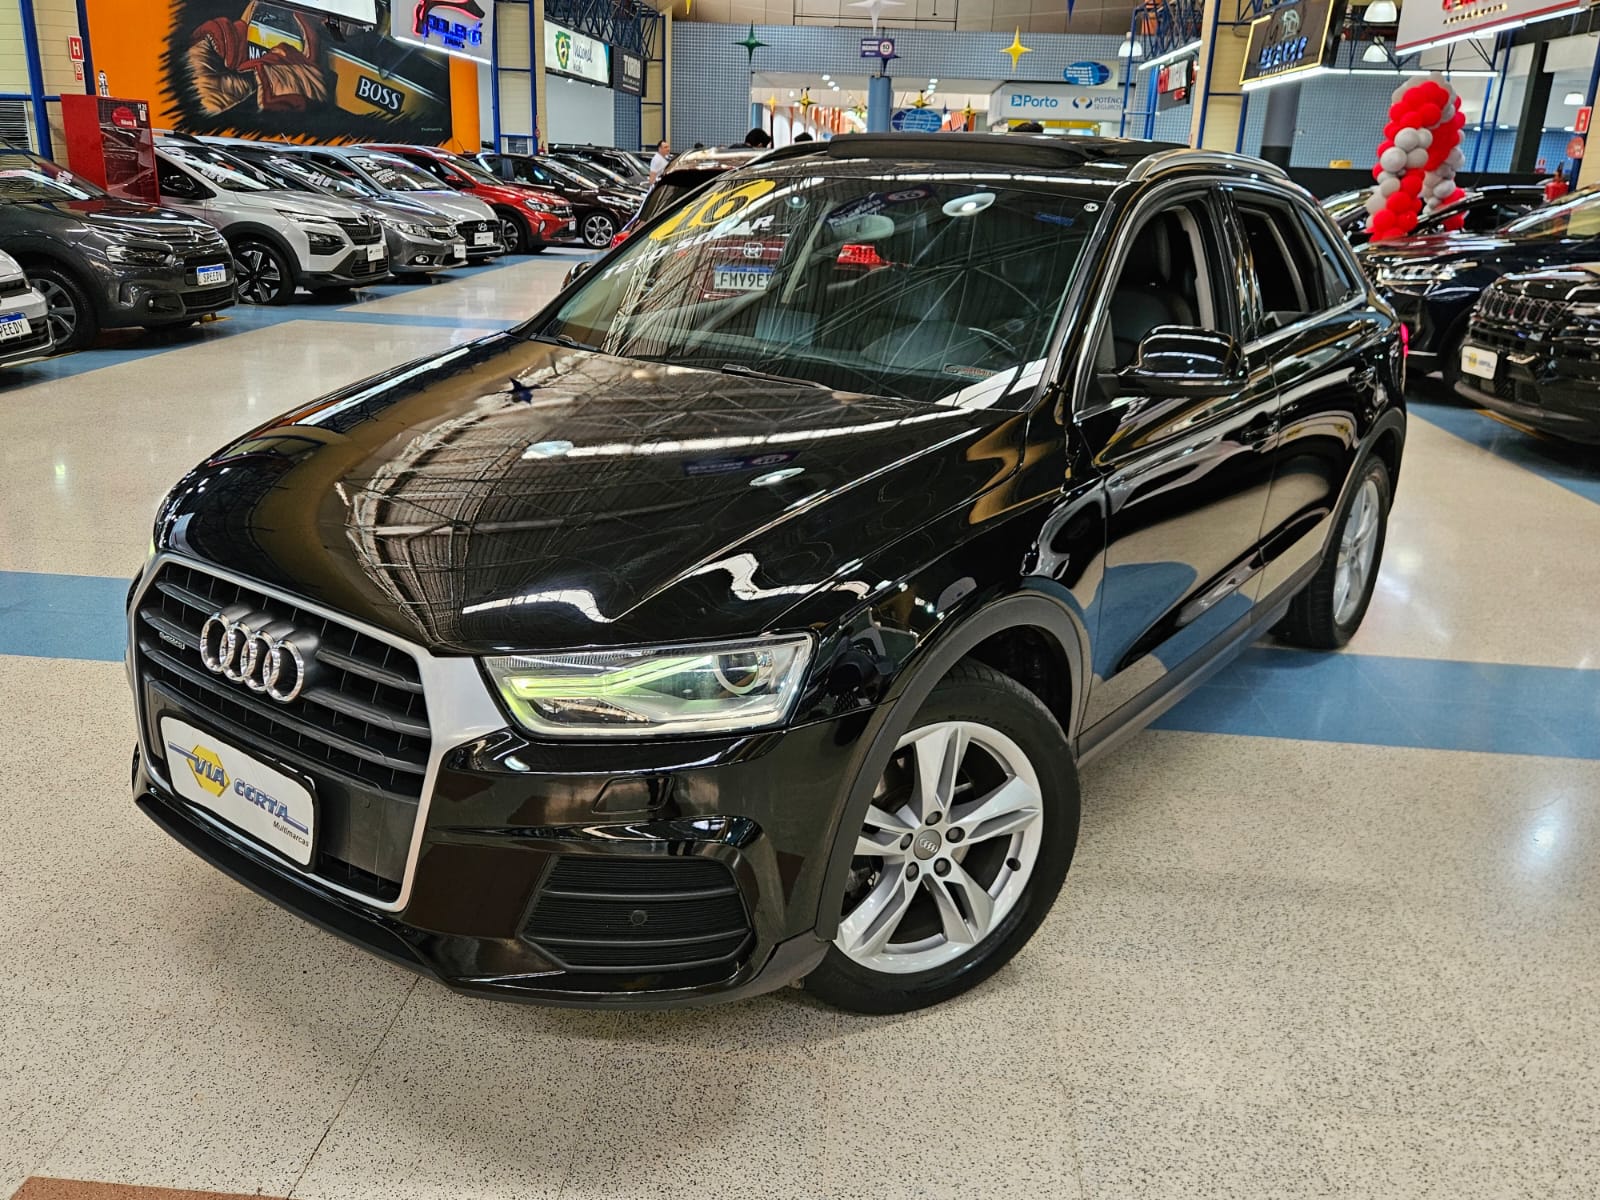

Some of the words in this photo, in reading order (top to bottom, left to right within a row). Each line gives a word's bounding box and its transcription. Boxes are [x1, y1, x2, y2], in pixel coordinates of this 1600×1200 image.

[72, 40, 80, 56] H
[358, 77, 400, 110] BOSS
[1023, 95, 1058, 108] Porto
[203, 272, 222, 282] SPEEDY
[193, 755, 227, 790] VIA
[234, 778, 289, 821] CERTA
[273, 821, 309, 847] Multimarcas
